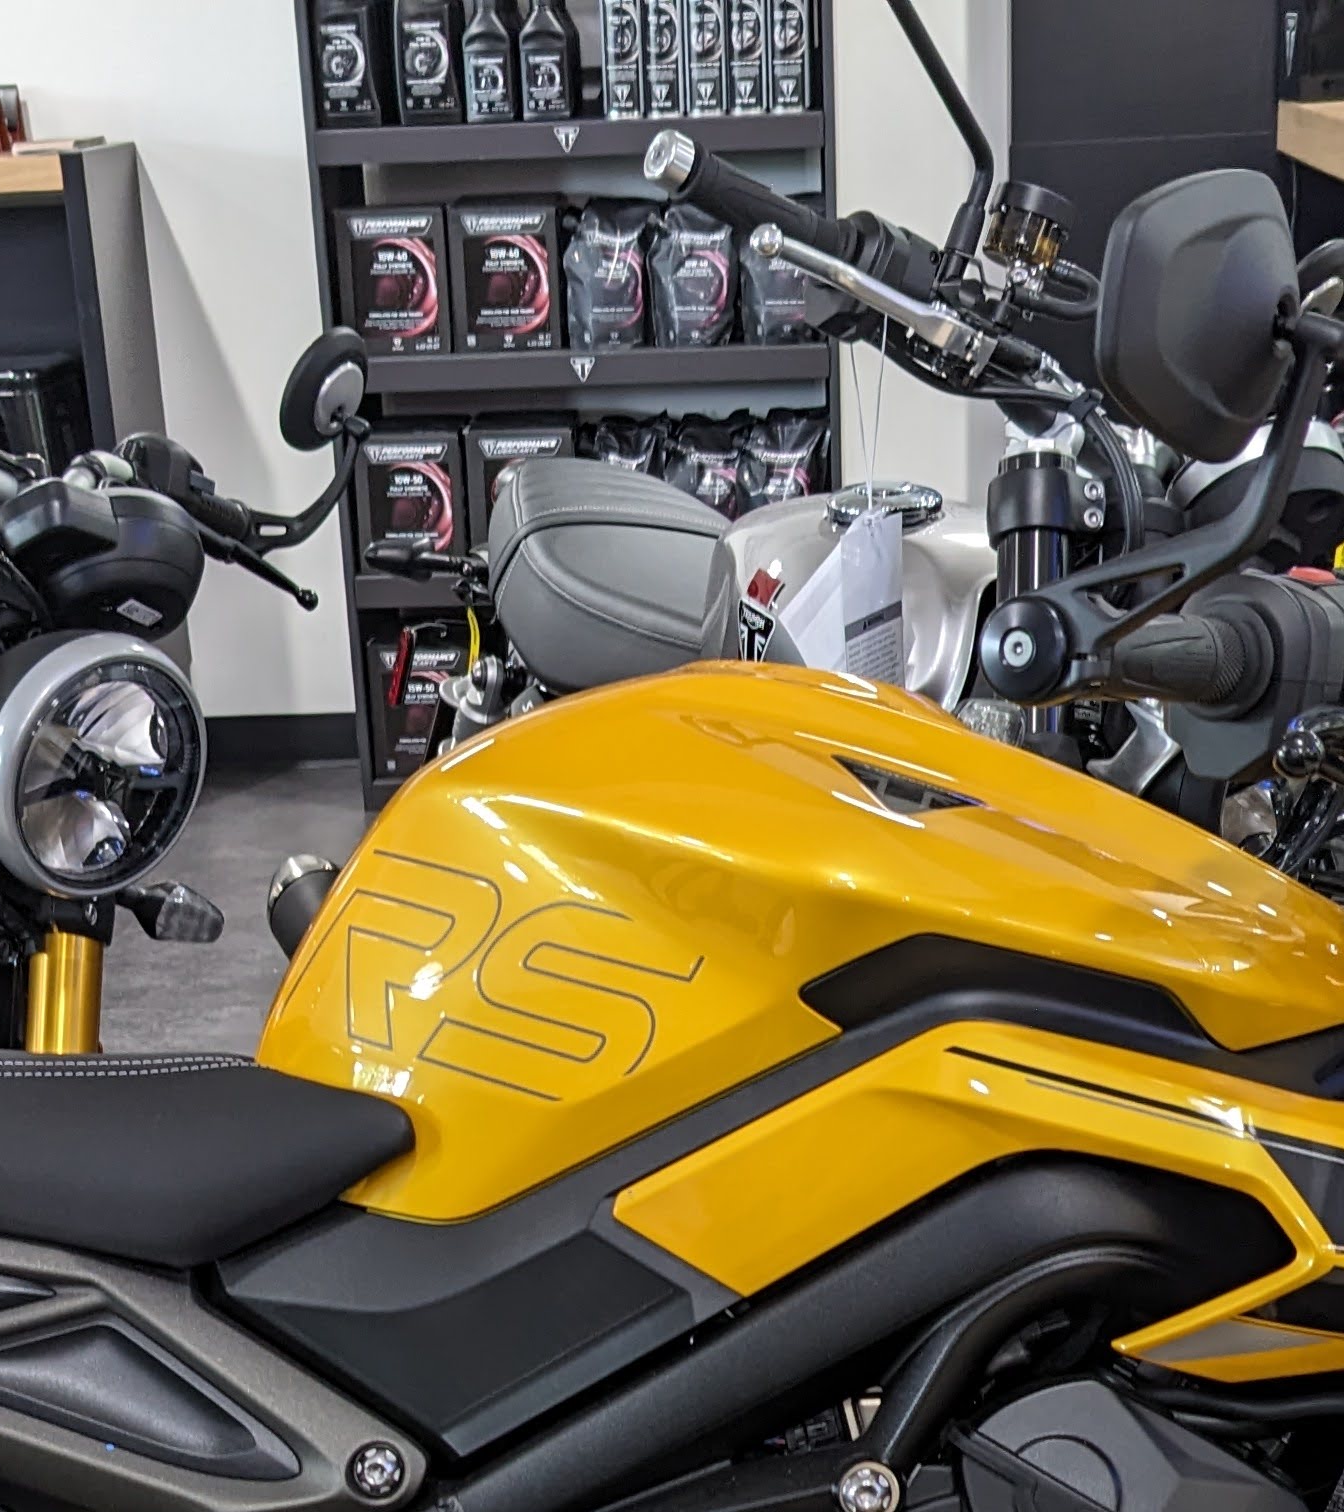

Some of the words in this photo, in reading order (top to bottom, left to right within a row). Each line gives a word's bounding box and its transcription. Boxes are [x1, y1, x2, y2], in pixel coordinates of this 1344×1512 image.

[365, 217, 428, 228] PERFORMANCE
[478, 215, 542, 225] PERFORMANCE
[378, 250, 408, 262] 10W-40
[490, 247, 520, 259] 10W-40
[496, 438, 557, 449] PERFORMANCE
[381, 445, 442, 455] PERFORMANCE
[394, 474, 423, 485] 10W-50
[742, 604, 766, 631] TRIUMPH
[412, 652, 456, 661] ORMANCE
[408, 683, 435, 693] 15W-50
[281, 850, 706, 1102] RS
